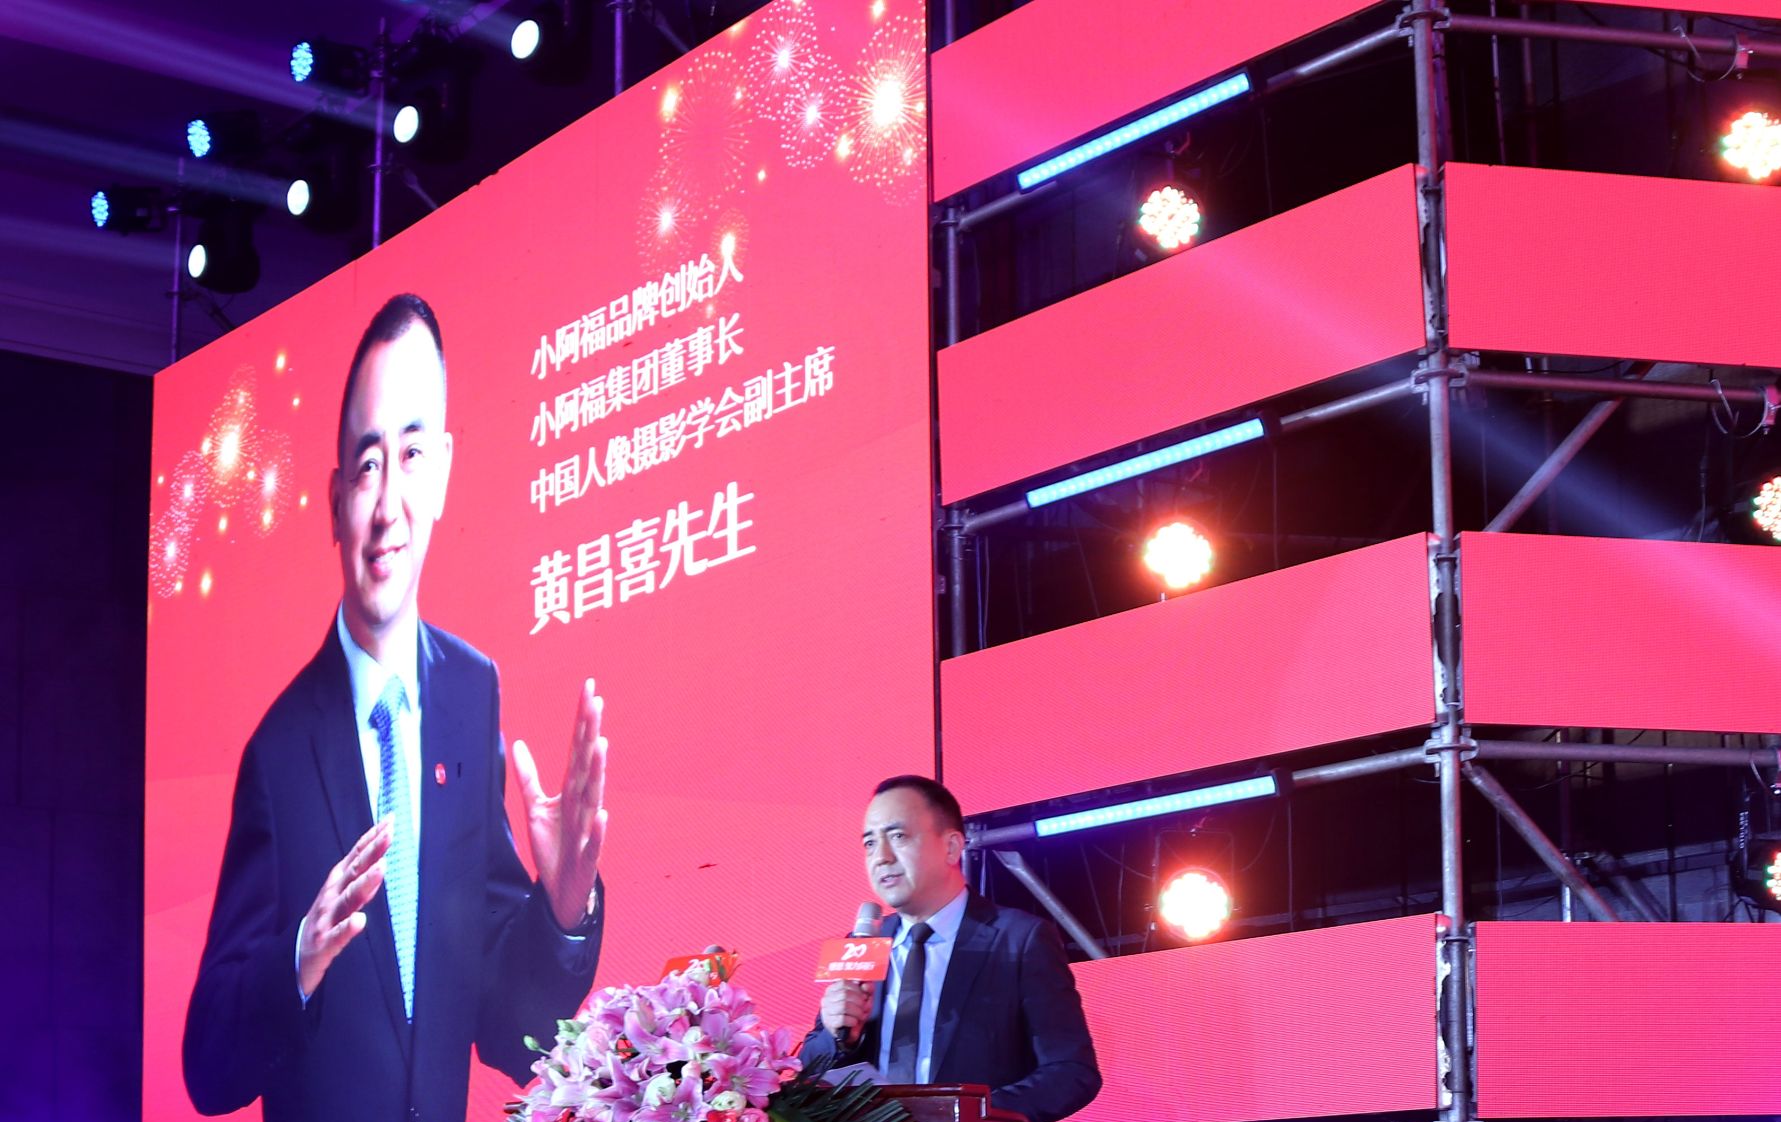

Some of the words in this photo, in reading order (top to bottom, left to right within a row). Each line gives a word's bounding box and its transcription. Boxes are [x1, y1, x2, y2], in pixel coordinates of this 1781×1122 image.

[530, 243, 743, 380] 小阿福品牌创始人
[530, 313, 744, 447] 小阿福集团董事长
[530, 345, 835, 513] 中国人像摄影学会副主席
[529, 481, 756, 635] 黄昌喜先生
